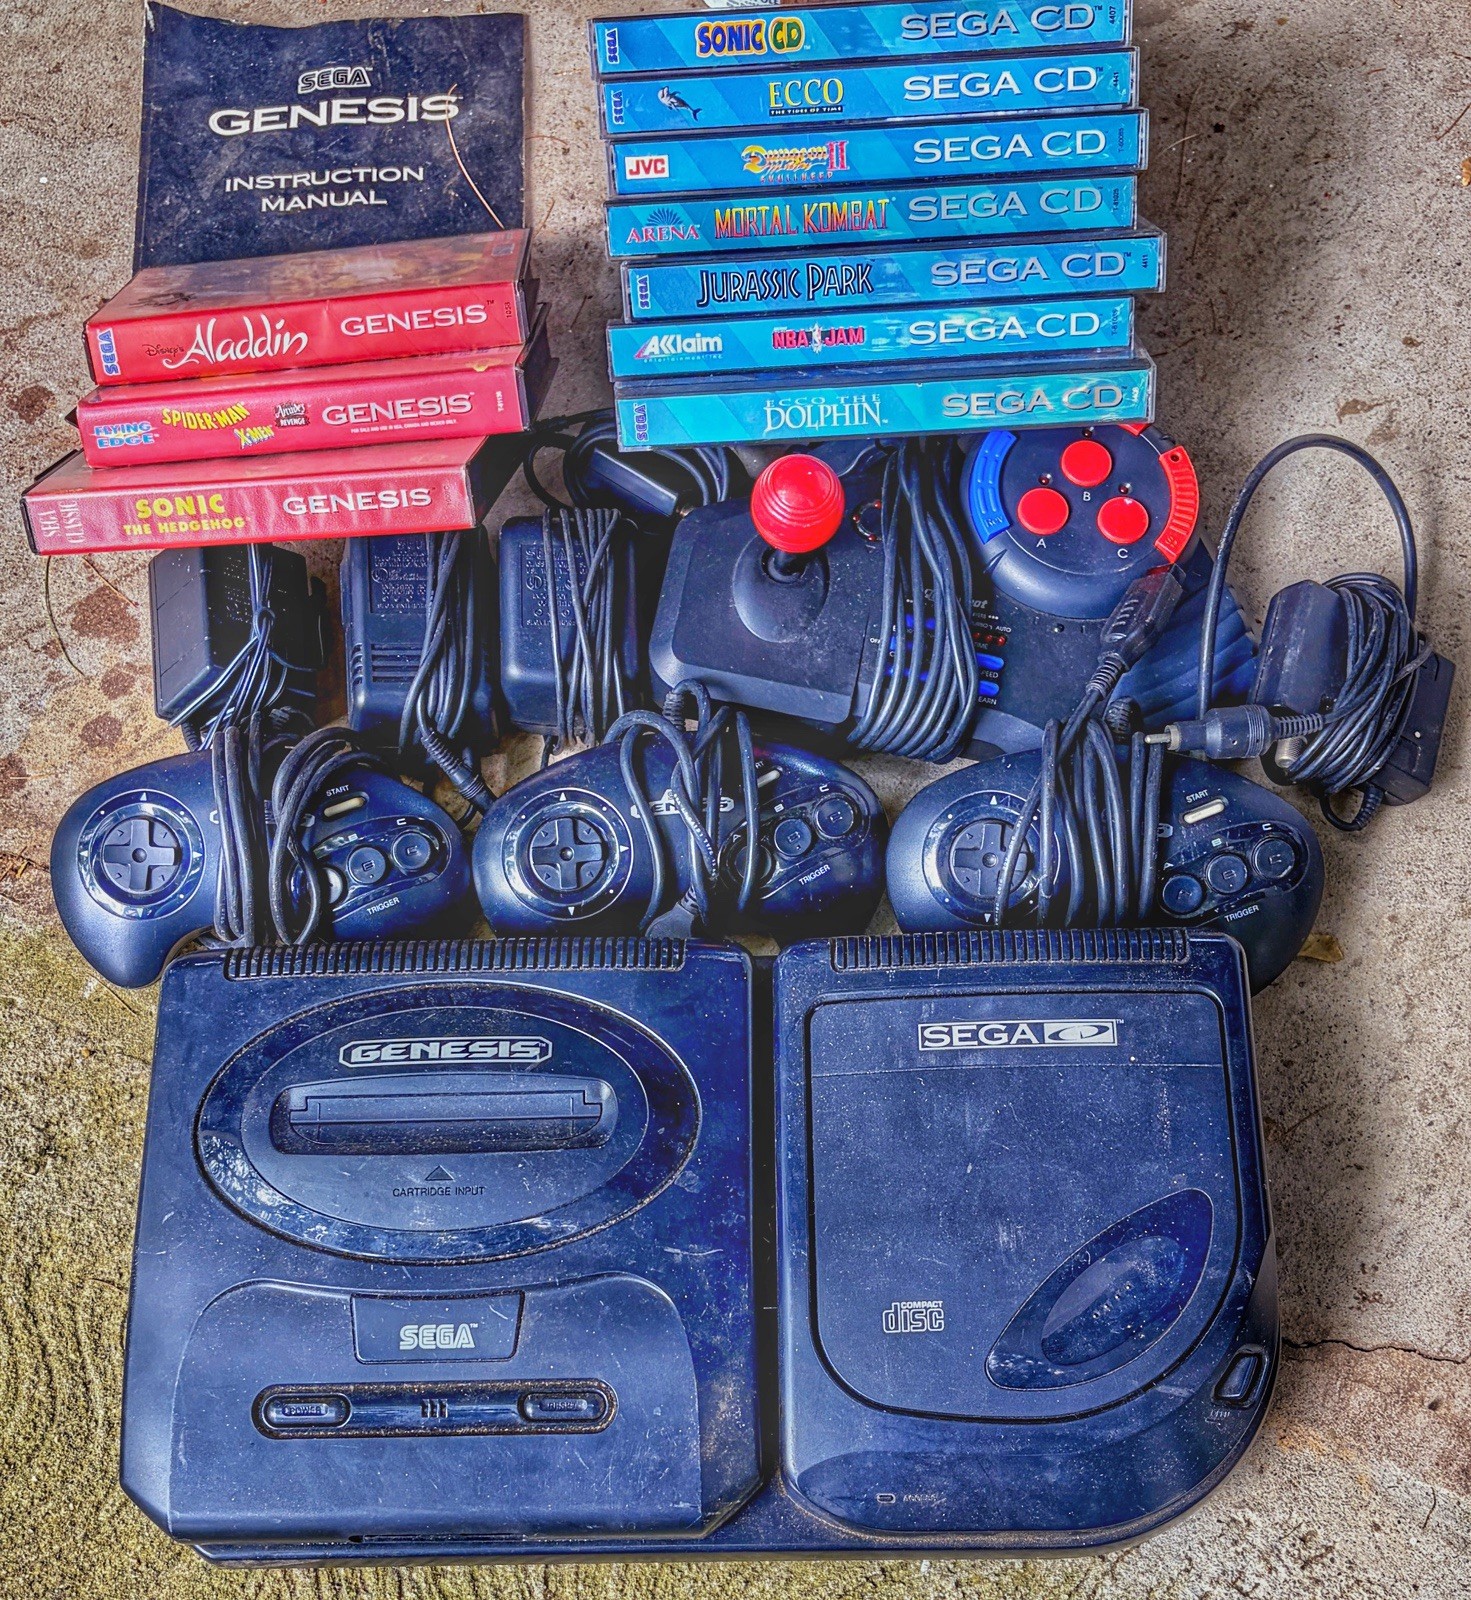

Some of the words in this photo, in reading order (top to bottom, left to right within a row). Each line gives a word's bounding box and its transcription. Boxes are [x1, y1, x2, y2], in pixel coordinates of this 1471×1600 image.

[901, 9, 1019, 41] SEGA
[1030, 4, 1095, 33] CD
[1108, 6, 1116, 25] 4407
[605, 28, 620, 64] SEGA
[697, 20, 767, 57] SONIC
[769, 17, 805, 54] CD
[298, 66, 372, 94] SEGA
[903, 70, 1022, 100] SEGA
[1034, 66, 1098, 93] CD
[769, 78, 844, 108] ECCO
[208, 95, 460, 136] GENESIS
[826, 140, 851, 171] II
[914, 134, 1033, 164] SEGA
[1042, 130, 1106, 156] CD
[225, 166, 425, 192] INSTRUCTION
[628, 157, 666, 177] JVC
[261, 190, 388, 212] MANUAL
[908, 191, 1028, 221] SEGA
[1040, 187, 1103, 214] CD
[715, 204, 799, 238] MORTAL
[803, 198, 890, 234] KOMBAT
[627, 224, 699, 244] ARENA
[931, 256, 1049, 286] SEGA
[1061, 252, 1126, 278] CD
[637, 275, 651, 309] SEGA
[697, 268, 802, 307] JURASSIC
[806, 263, 874, 300] PARK
[340, 304, 489, 337] GENESIS
[908, 316, 1028, 345] SEGA
[1036, 312, 1100, 338] CD
[162, 313, 309, 369] Aladdin
[772, 329, 810, 350] NBA
[823, 326, 865, 347] JAM
[97, 329, 121, 376] SEGA
[322, 394, 474, 426] GENESIS
[766, 396, 826, 408] ECCO
[836, 393, 881, 404] THE
[942, 388, 1056, 418] SEGA
[1062, 385, 1124, 412] CD
[94, 422, 152, 436] FLYING
[634, 403, 649, 442] SEGA
[763, 401, 882, 434] DOLPHIN
[97, 432, 156, 449] EDGE
[234, 425, 275, 450] X-MEN
[135, 492, 226, 520] SONIC
[282, 487, 432, 517] GENESIS
[1083, 491, 1091, 501] B
[38, 510, 61, 537] SEGA
[59, 500, 86, 544] CLASSIC
[123, 522, 155, 537] THE
[157, 516, 246, 535] HEDGEHOG
[1036, 538, 1047, 549] A
[1117, 548, 1129, 559] C
[995, 625, 1012, 633] AUTO
[326, 784, 349, 798] START
[1185, 789, 1210, 804] START
[774, 803, 784, 813] B
[396, 818, 408, 826] C
[1261, 823, 1272, 831] C
[732, 834, 741, 843] A
[1211, 838, 1223, 847] B
[798, 864, 831, 887] TRIGGER
[1163, 861, 1174, 870] A
[366, 896, 400, 916] TRIGGER
[1224, 904, 1260, 923] TRIGGER
[922, 1023, 1041, 1047] SEGA
[350, 1040, 543, 1063] GENESIS
[392, 1187, 452, 1198] CARTRIDGE
[455, 1185, 485, 1197] INPUT
[901, 1300, 944, 1309] COMPACT
[882, 1302, 945, 1333] disc
[399, 1323, 476, 1350] SEGA
